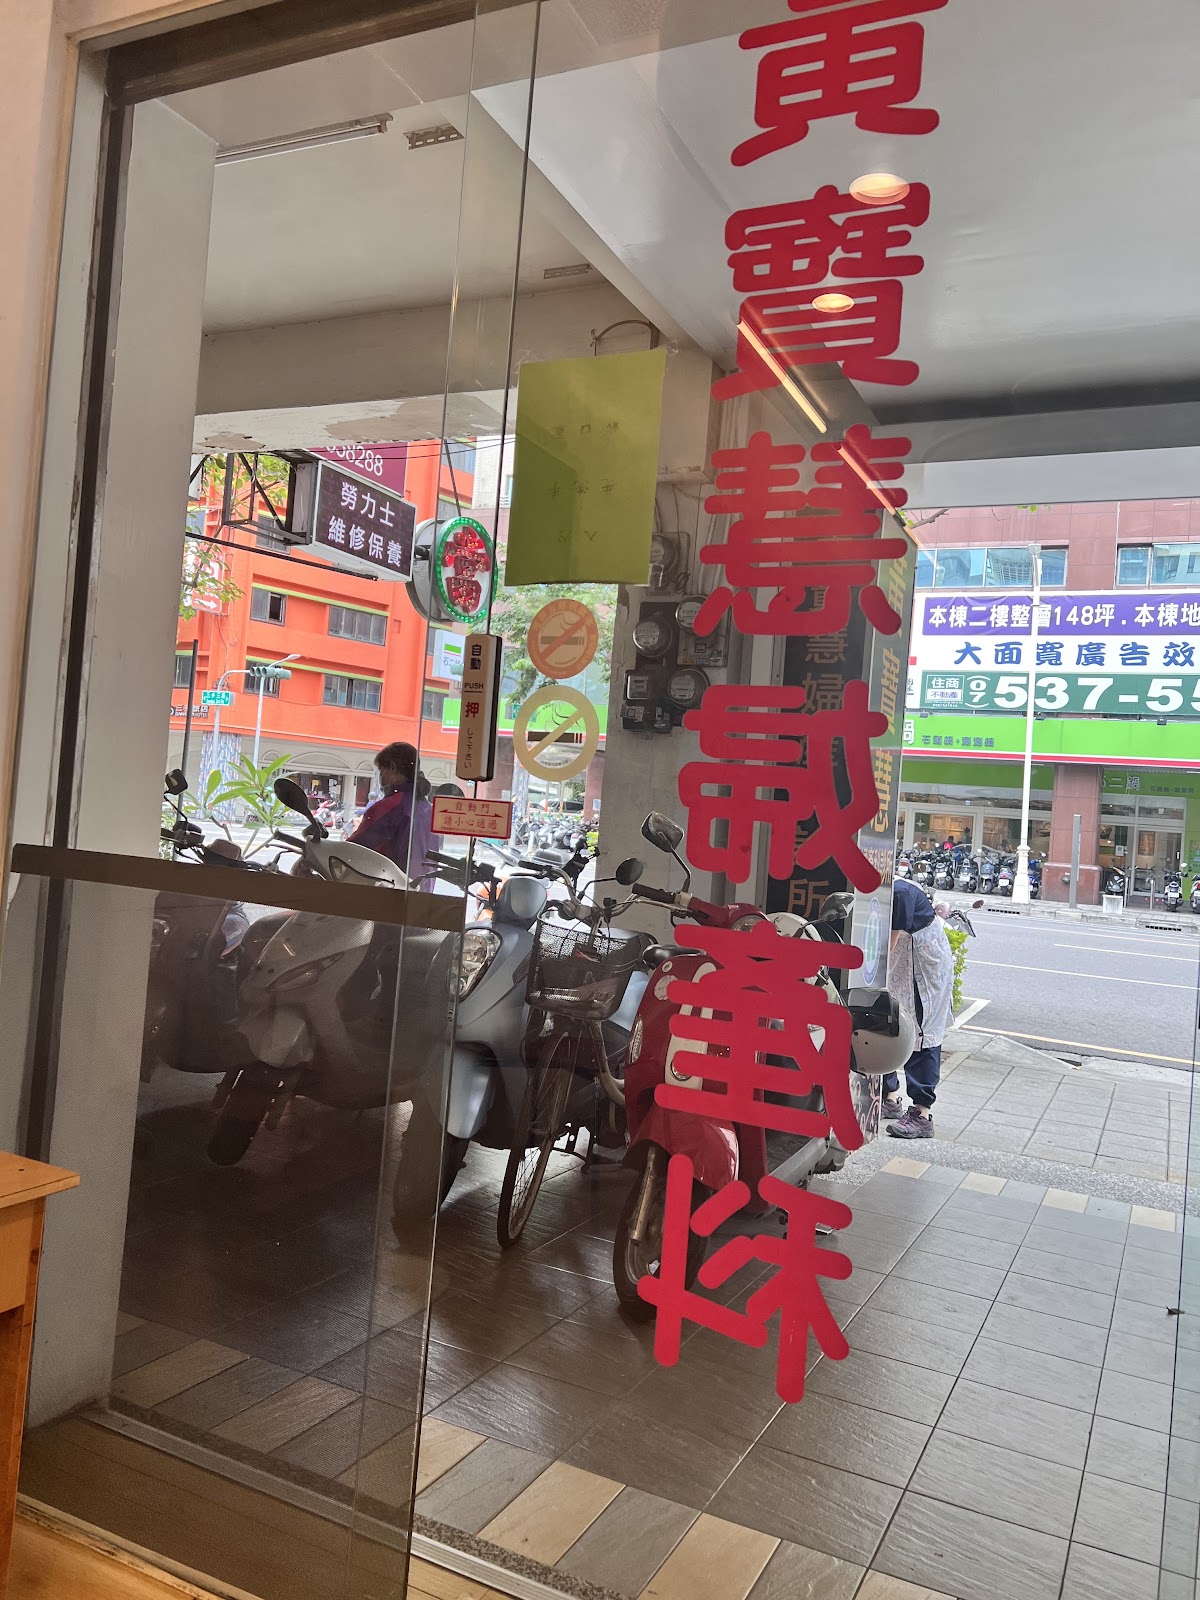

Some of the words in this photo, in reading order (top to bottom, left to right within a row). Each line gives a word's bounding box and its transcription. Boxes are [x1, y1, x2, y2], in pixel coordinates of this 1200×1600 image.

[340, 481, 396, 527] 勞力士
[327, 515, 403, 567] 維修保養
[470, 644, 481, 670] 自動
[464, 682, 484, 690] PUSH
[931, 677, 960, 689] 住商
[930, 691, 959, 699] 不動產
[993, 676, 1200, 713] 537-5
[465, 701, 480, 719] 押
[464, 728, 474, 769] して下さい
[456, 800, 490, 814] 自動門
[444, 815, 498, 830] 請小心通過
